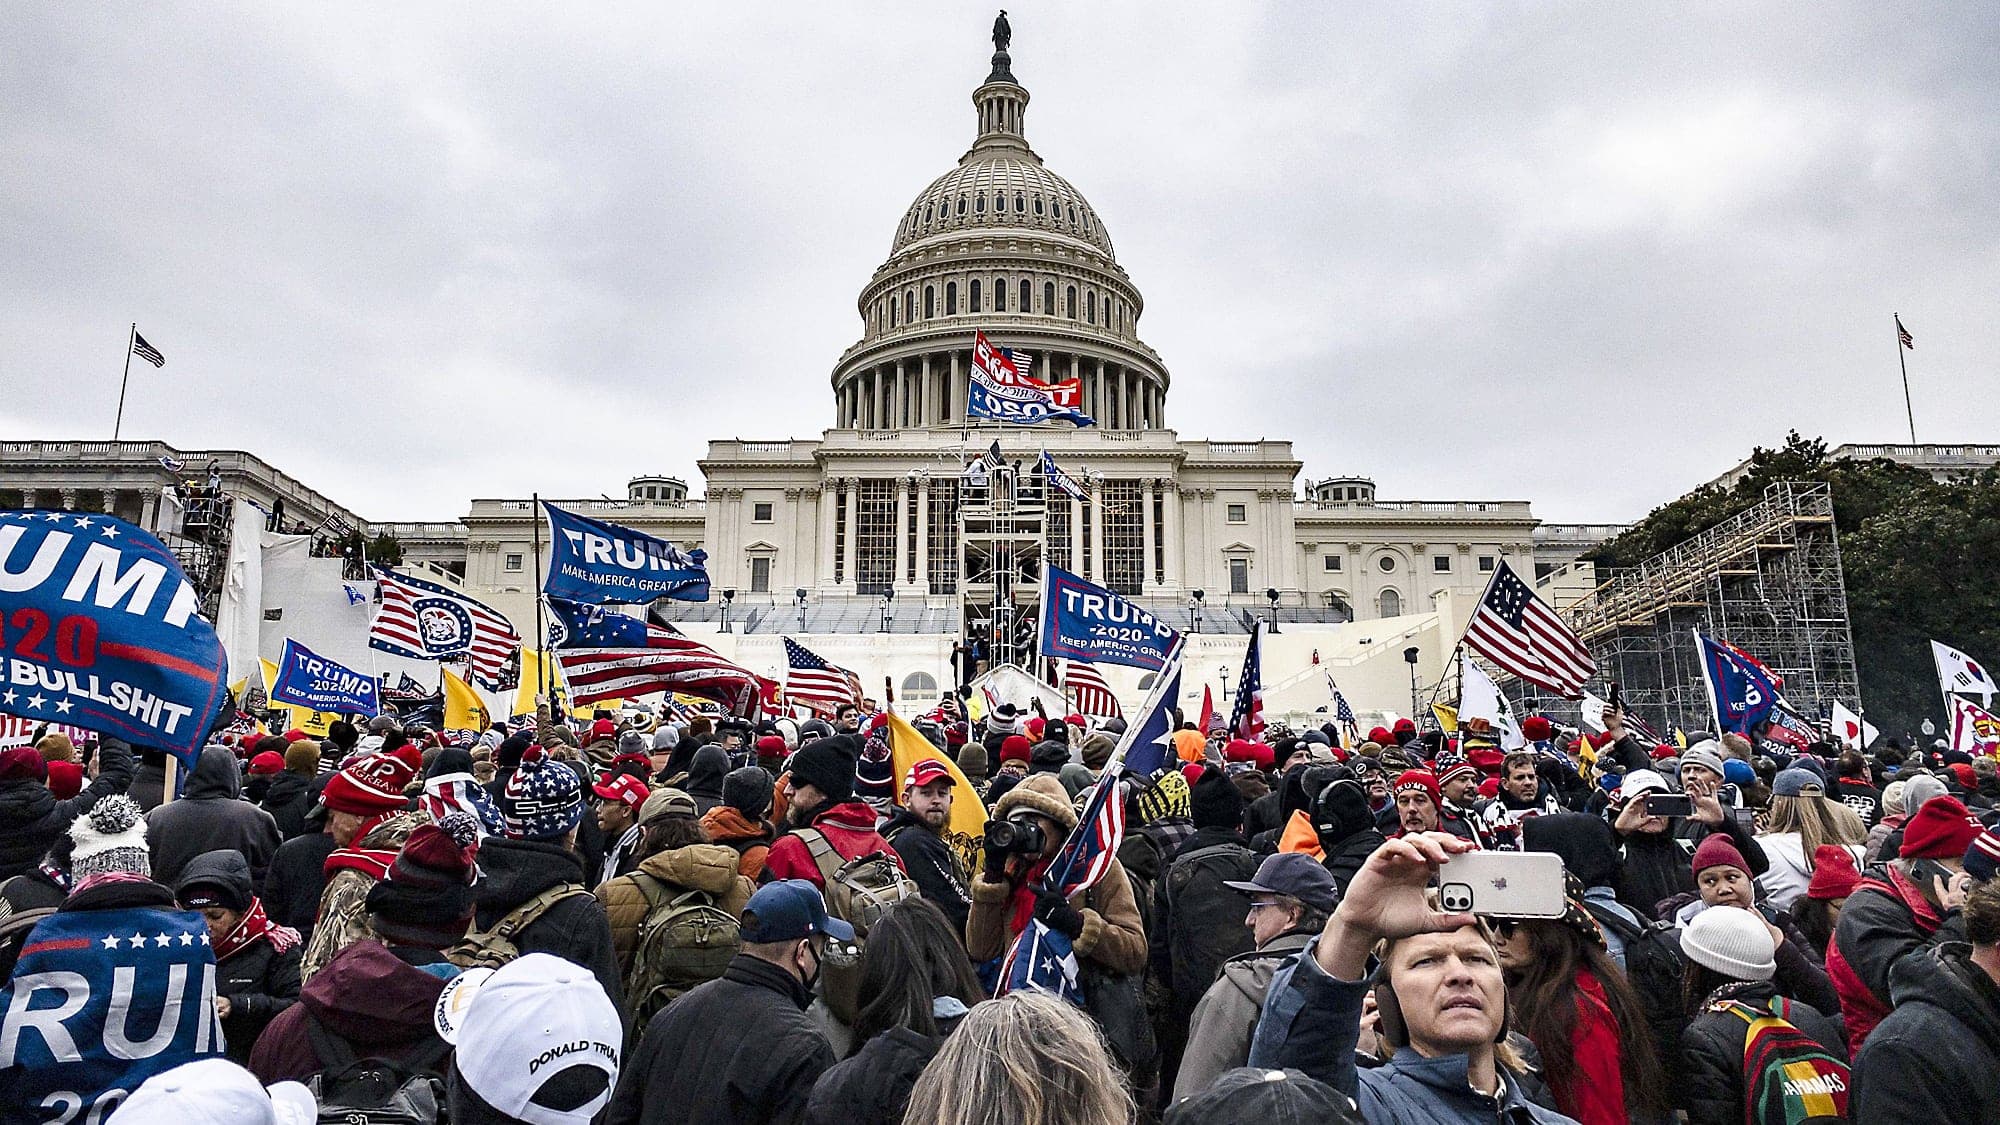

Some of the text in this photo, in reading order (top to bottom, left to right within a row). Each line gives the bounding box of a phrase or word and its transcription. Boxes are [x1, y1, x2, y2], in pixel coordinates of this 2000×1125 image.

[562, 563, 588, 580] MAKE
[589, 573, 636, 588] AMERICA
[638, 579, 673, 592] GREAT
[1062, 587, 1172, 638] TRUMP
[0, 607, 99, 668] 20
[1060, 635, 1087, 649] KEEP
[1090, 639, 1137, 653] AMERICA
[295, 652, 373, 697] TRUMP
[10, 658, 193, 735] BULLSHIT
[308, 694, 341, 703] AMERICA
[529, 1040, 590, 1075] DONALD
